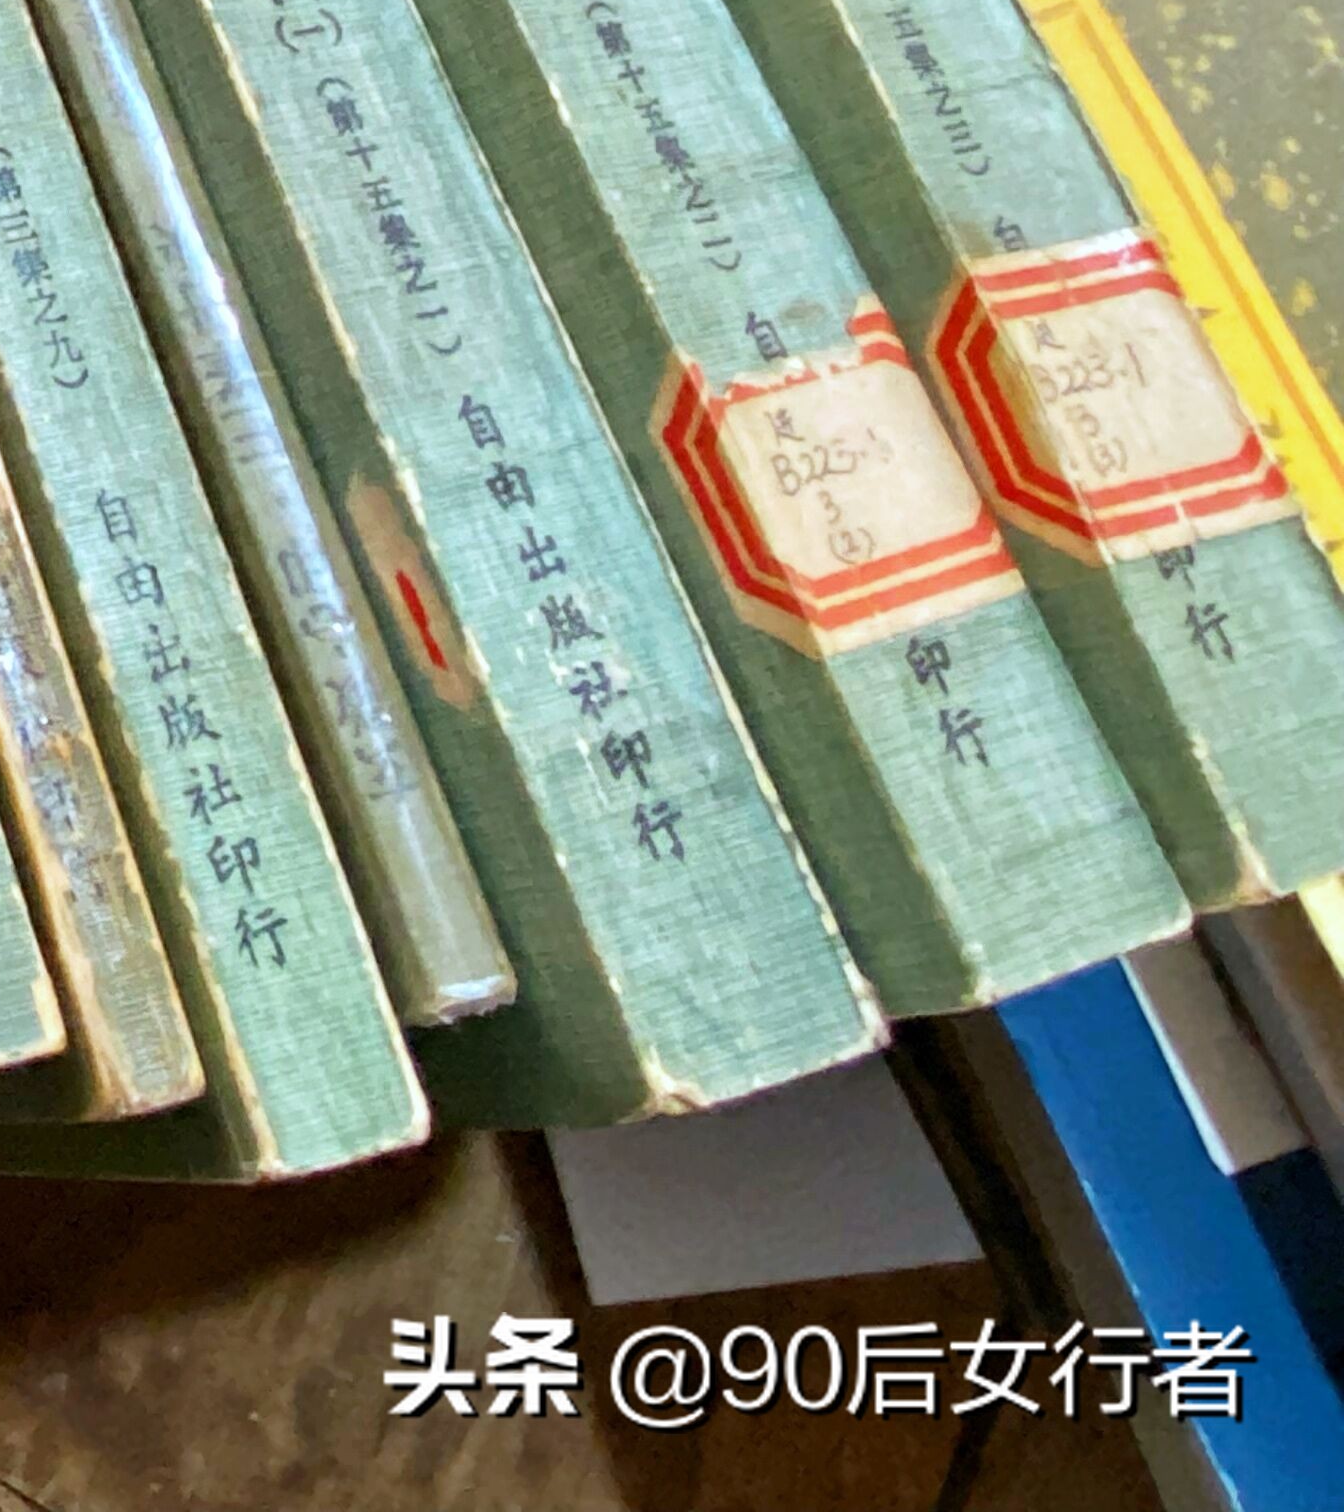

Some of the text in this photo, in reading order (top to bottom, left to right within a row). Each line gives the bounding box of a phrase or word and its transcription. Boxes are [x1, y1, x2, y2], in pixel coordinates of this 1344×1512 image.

[744, 311, 789, 362] 自
[457, 394, 688, 863] 自由出版社印行
[1153, 546, 1238, 665] 印行
[91, 487, 291, 971] 自由出版社印行
[905, 639, 992, 769] 印行
